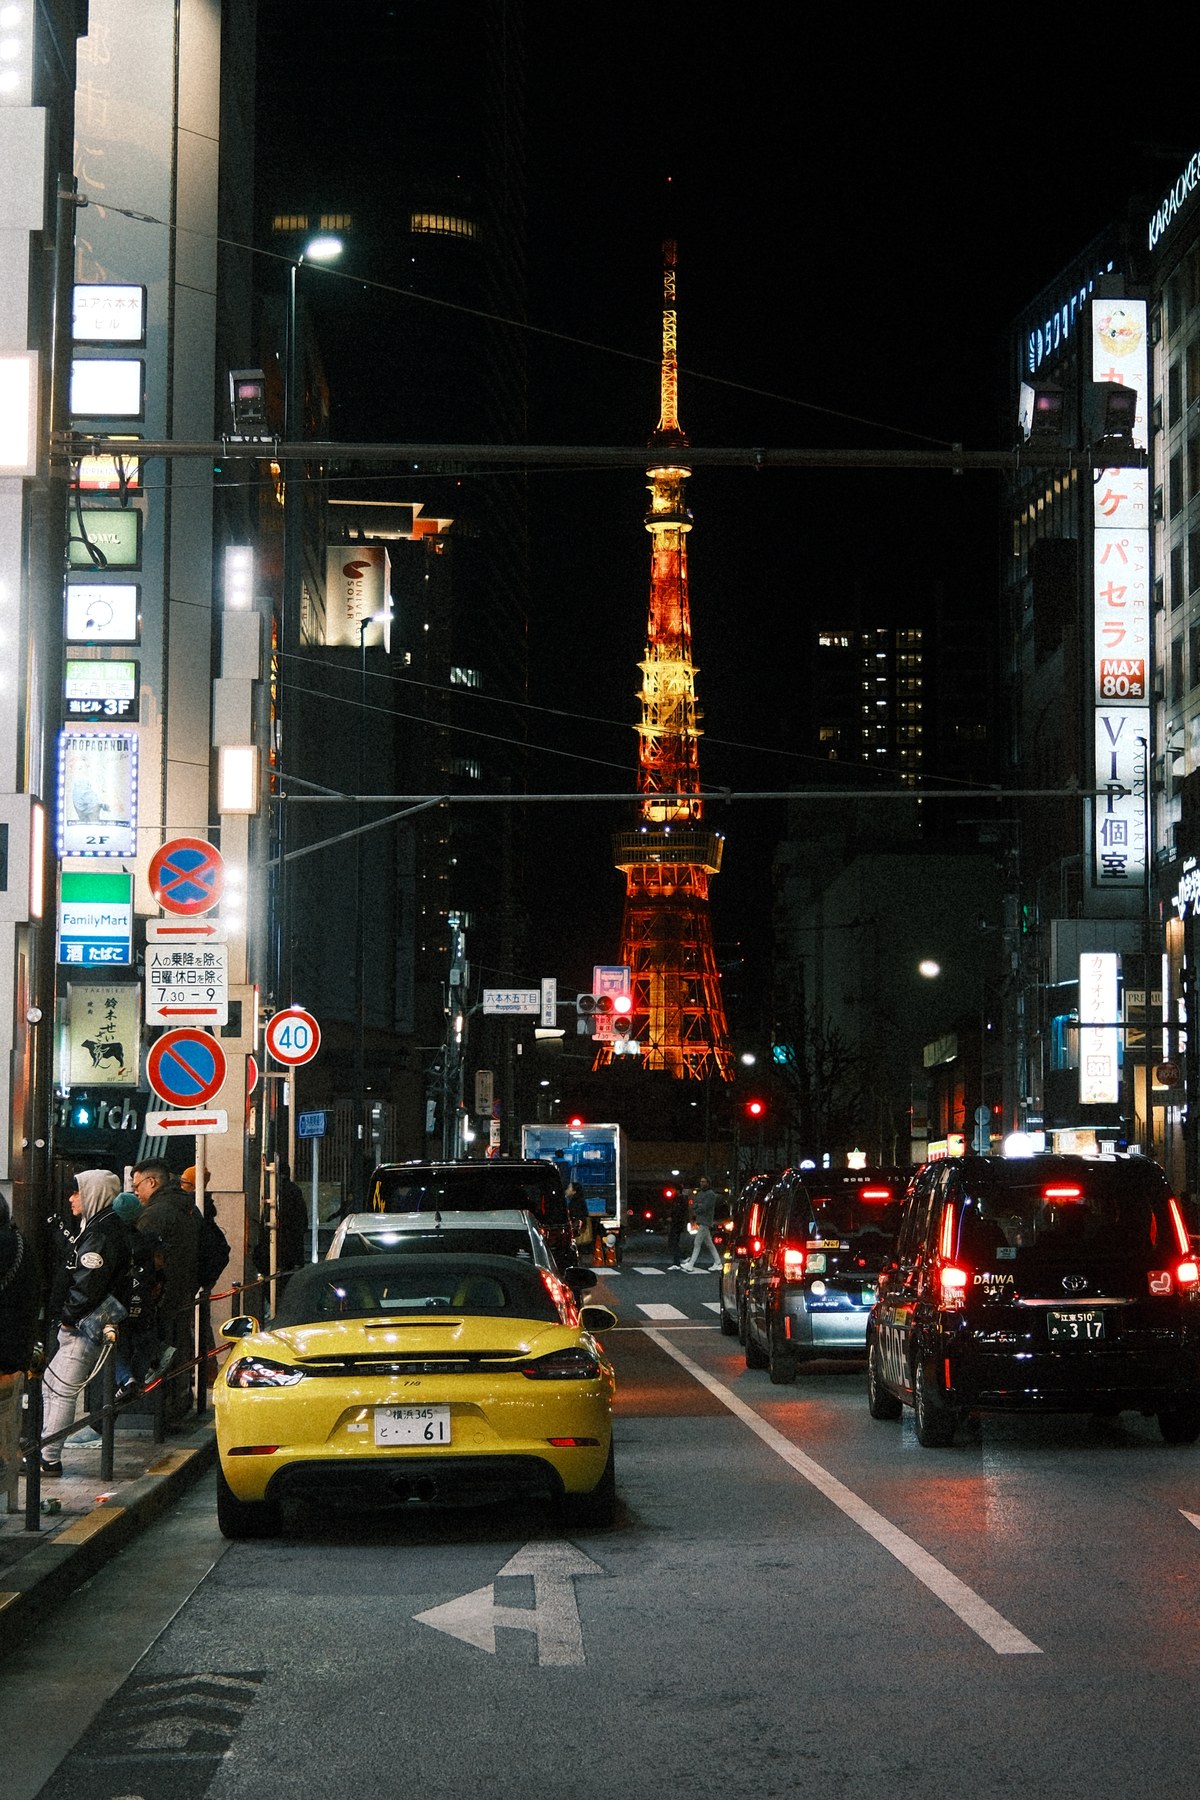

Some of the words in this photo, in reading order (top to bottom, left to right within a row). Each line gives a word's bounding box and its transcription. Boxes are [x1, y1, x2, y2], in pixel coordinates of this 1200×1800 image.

[346, 580, 354, 620] SOLAR
[1099, 539, 1130, 649] パセラ
[1133, 545, 1145, 645] PASELA
[1103, 660, 1141, 676] MAX
[1103, 676, 1142, 697] 80名
[103, 699, 130, 715] 3F
[66, 739, 129, 751] PROPAGANDA
[85, 836, 110, 845] 2F
[63, 914, 128, 928] FamilyMart
[66, 944, 84, 962] 酒
[88, 946, 124, 961] たばこ
[151, 952, 223, 967] 人の乗降を除く
[486, 993, 538, 1004] 六本木五丁目
[278, 1025, 308, 1049] 40
[973, 1274, 1015, 1285] DAIWA
[983, 1285, 1005, 1294] 317
